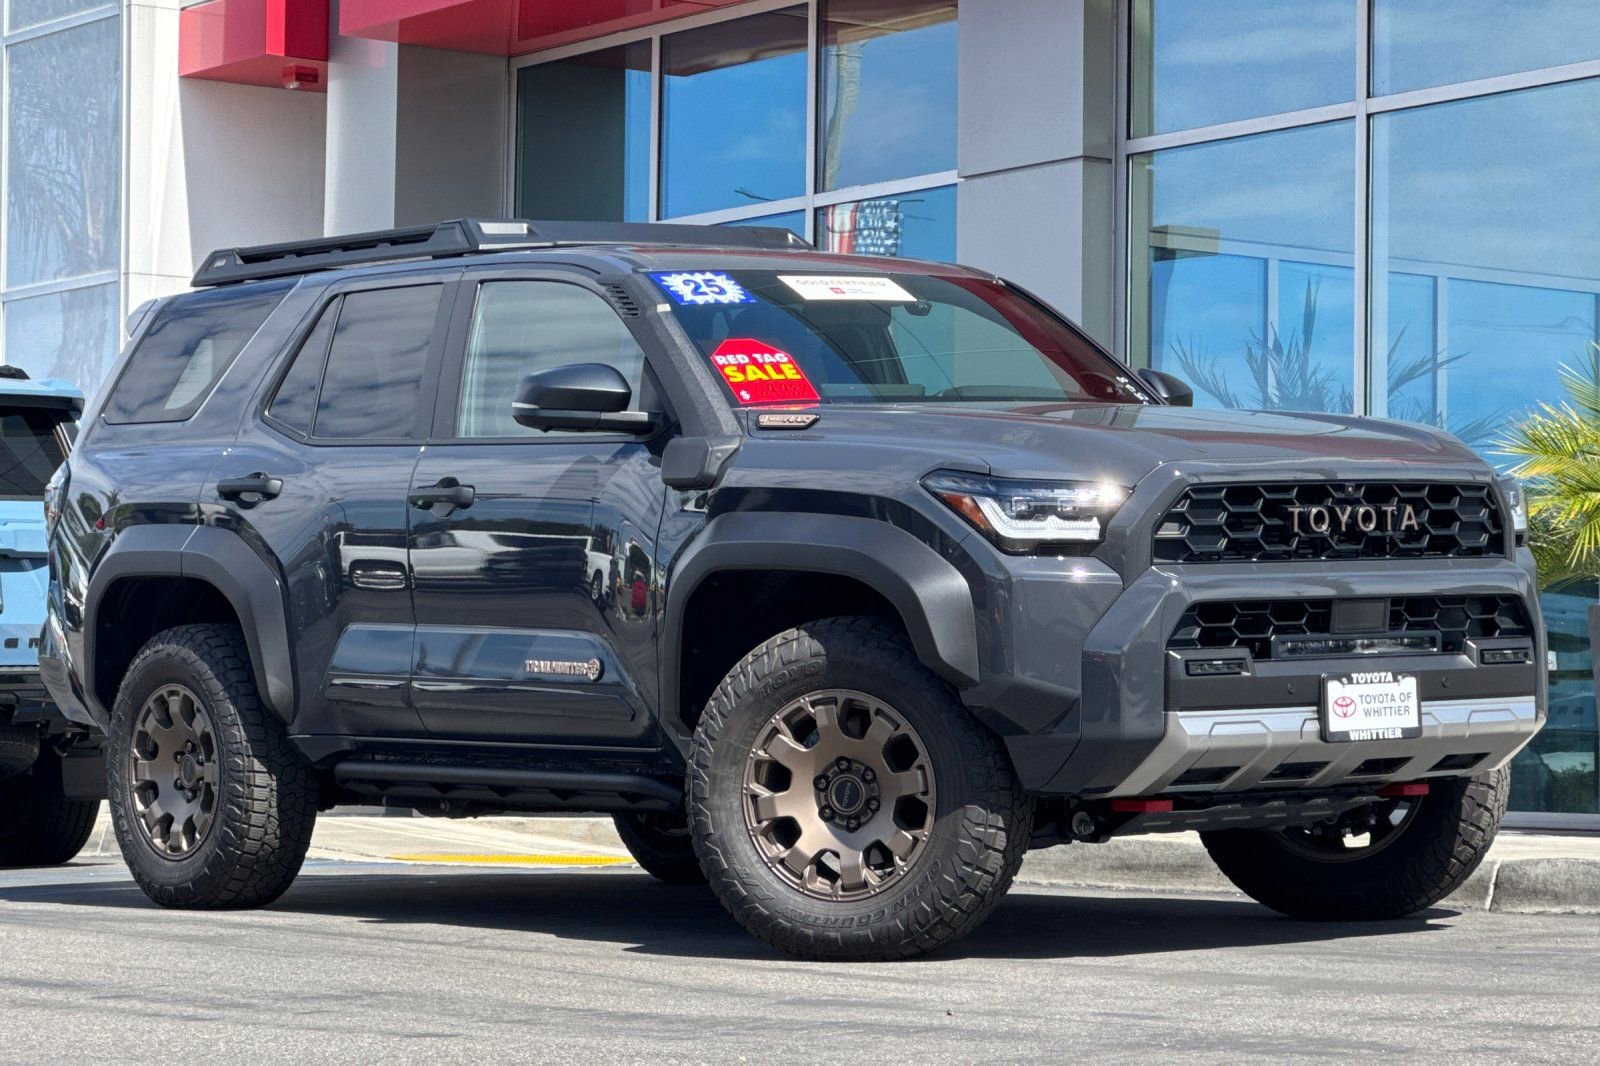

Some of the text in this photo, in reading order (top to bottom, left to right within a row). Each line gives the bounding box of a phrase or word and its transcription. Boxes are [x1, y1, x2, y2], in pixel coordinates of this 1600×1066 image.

[682, 278, 727, 296] 25
[714, 353, 789, 365] RED TAG
[723, 363, 802, 383] SALE
[740, 389, 751, 400] $
[1288, 504, 1419, 533] TOYOTA
[1351, 672, 1394, 684] TOYOTA
[1358, 692, 1412, 705] TOYOTA OF
[1362, 705, 1411, 718] WHITTIER
[1348, 727, 1403, 741] WHITTIER
